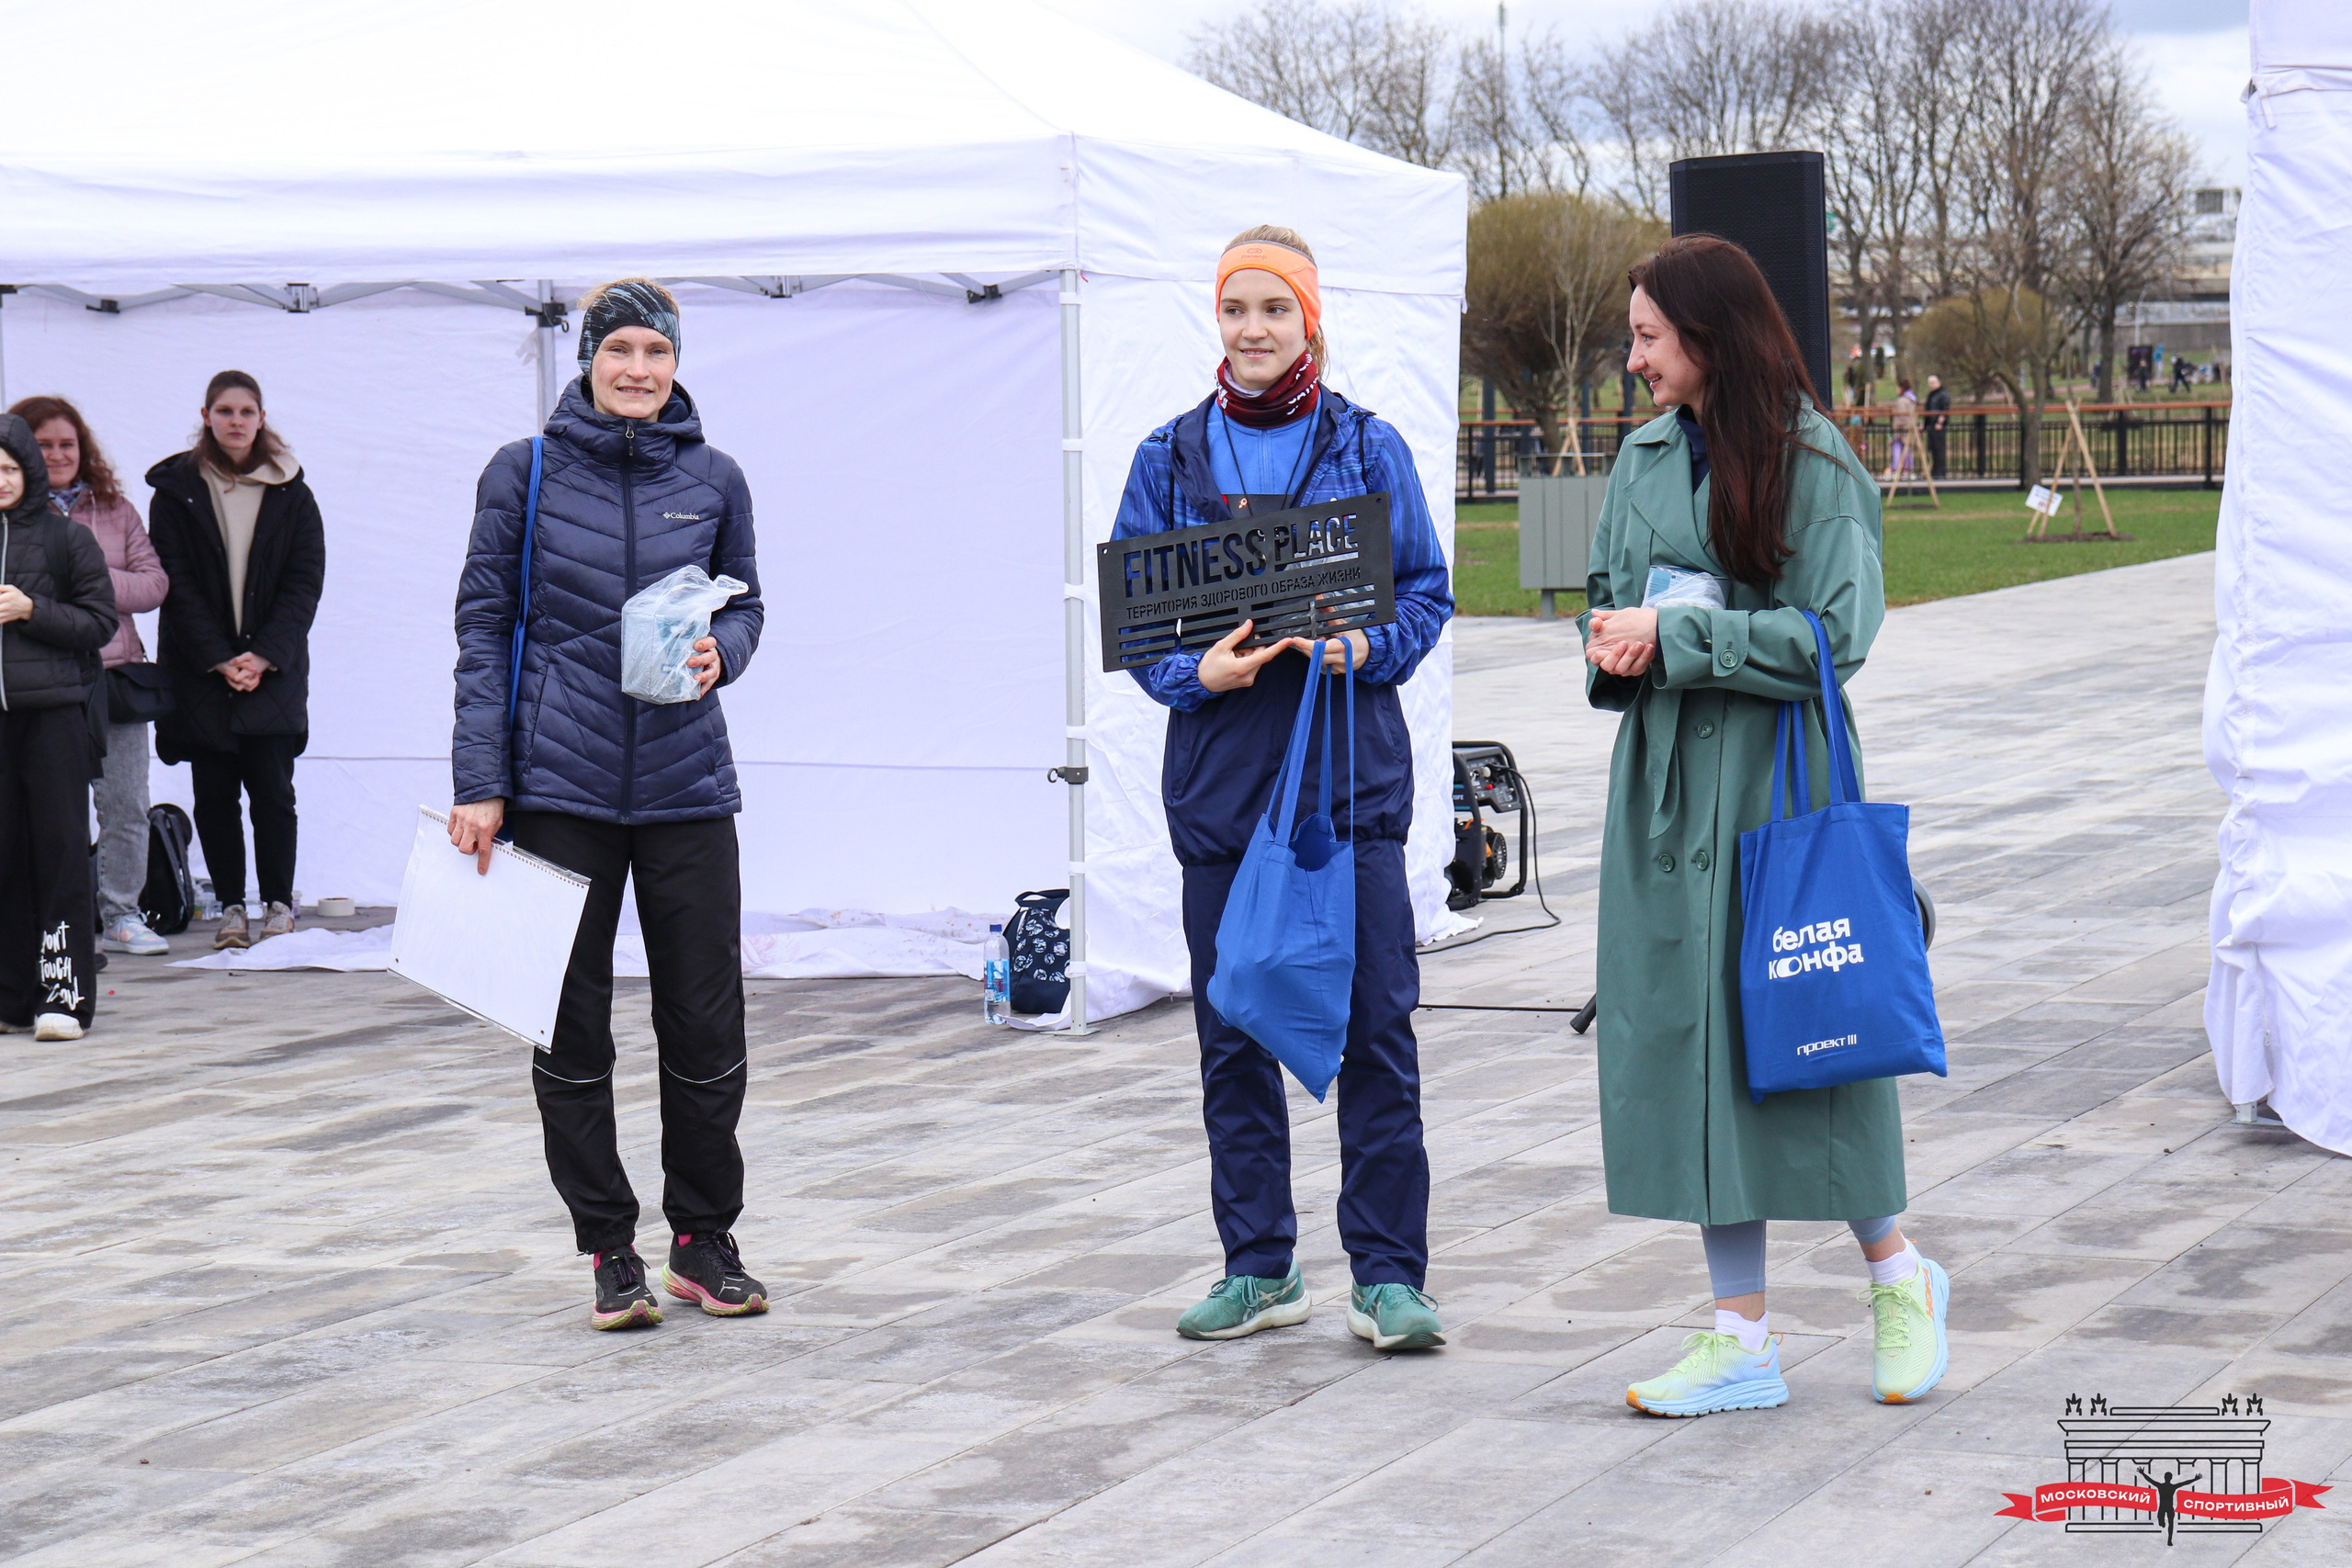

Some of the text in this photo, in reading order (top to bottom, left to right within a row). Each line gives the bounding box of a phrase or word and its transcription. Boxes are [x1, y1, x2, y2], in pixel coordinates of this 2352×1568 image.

[670, 512, 700, 520] Columbia
[1123, 513, 1359, 598] FITNESS PLACE
[1125, 567, 1361, 620] ТЕРРИТОРИЯ ЗДОРОВОГО ОБРАЗА ЖИЗНИ
[1772, 918, 1852, 953] белая
[1768, 941, 1864, 980] конфа
[1796, 1037, 1847, 1056] проект
